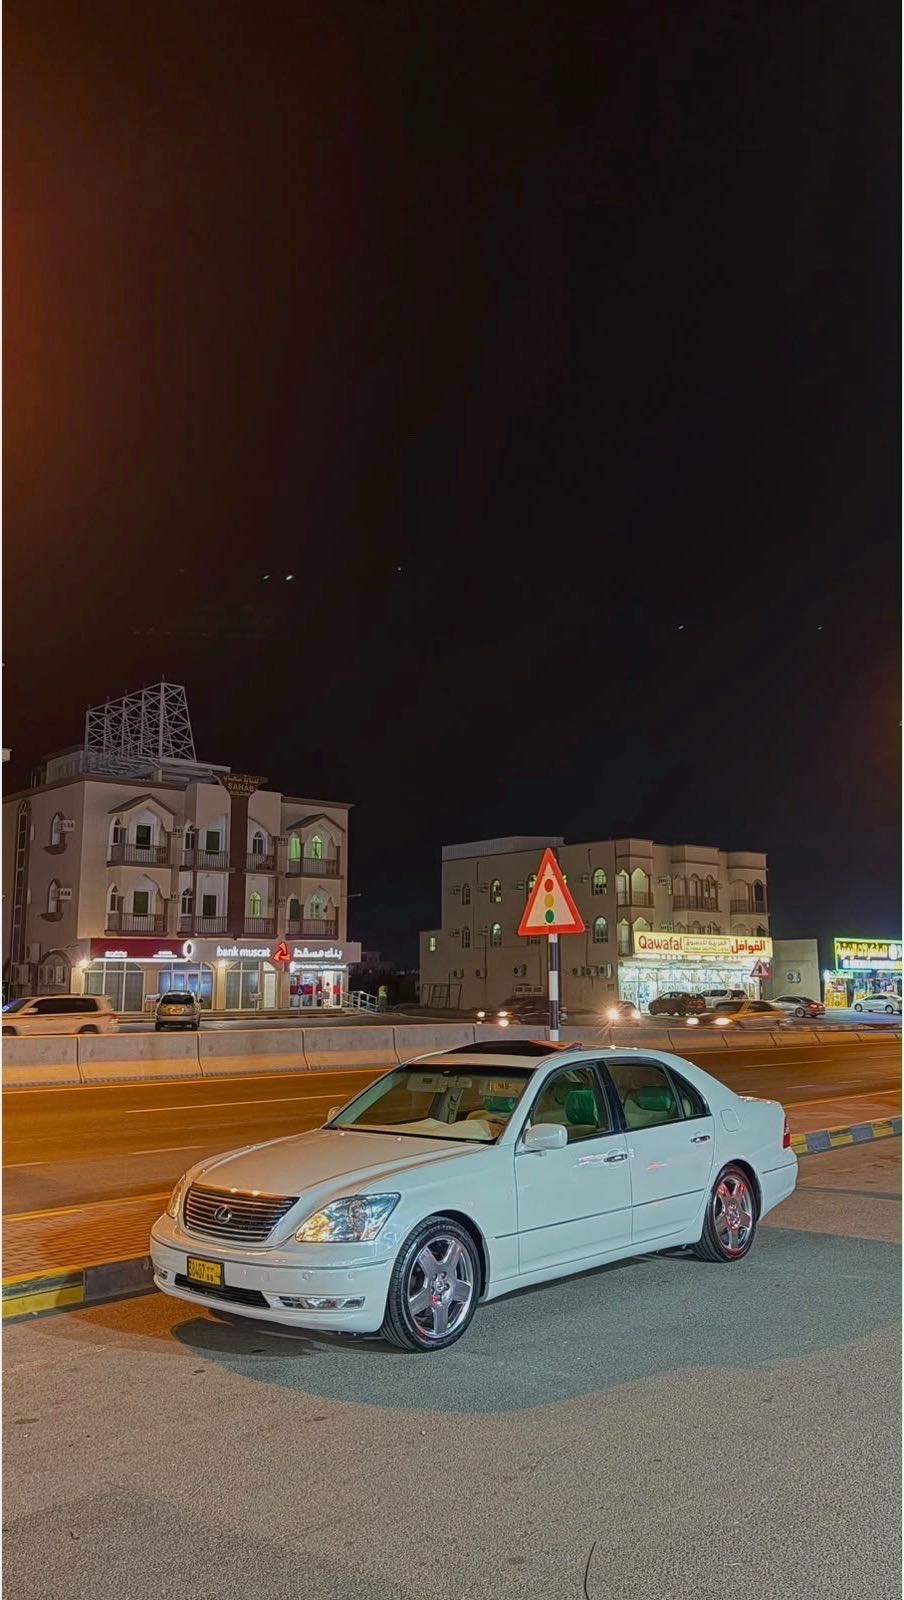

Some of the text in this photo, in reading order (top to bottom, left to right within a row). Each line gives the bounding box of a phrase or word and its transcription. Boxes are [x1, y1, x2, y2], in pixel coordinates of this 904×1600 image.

[639, 935, 682, 951] Qawafal
[731, 938, 766, 954] القوافل
[217, 946, 271, 957] bank muscat
[293, 947, 342, 959] بنك مسقط
